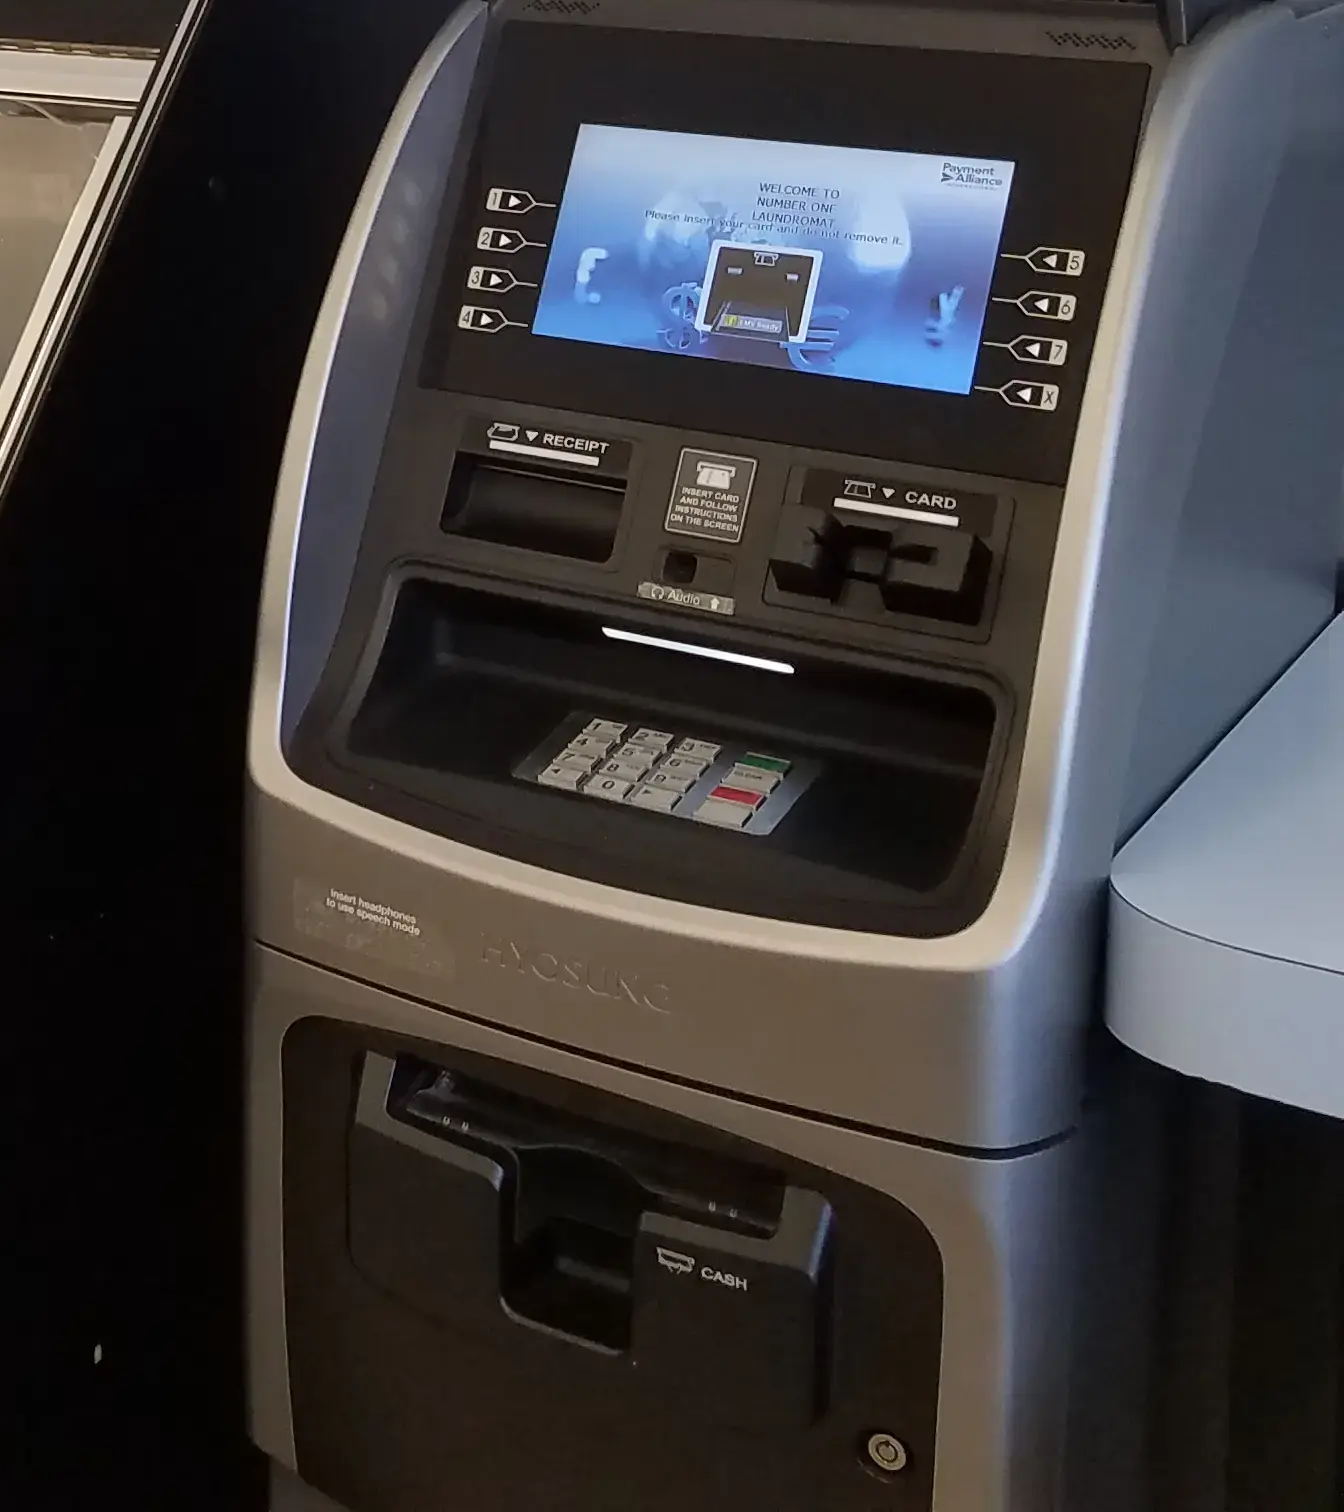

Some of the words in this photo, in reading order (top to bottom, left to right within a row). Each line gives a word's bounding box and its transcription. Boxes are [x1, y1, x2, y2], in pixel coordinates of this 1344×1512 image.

[943, 162, 995, 176] Payment
[955, 173, 1003, 186] Alliance
[758, 182, 818, 199] WELCOME
[823, 187, 841, 199] TO
[492, 192, 499, 206] 1
[756, 196, 807, 212] NUMBER
[645, 209, 681, 222] Please
[719, 218, 744, 231] your
[748, 220, 773, 232] card
[844, 231, 888, 244] remove
[752, 210, 836, 229] LAUNDROMAT
[481, 231, 490, 246] 2
[1069, 255, 1080, 270] 5
[471, 270, 480, 285] 3
[1061, 299, 1071, 315] 6
[462, 310, 471, 324] 4
[1053, 344, 1063, 360] 7
[1043, 390, 1055, 405] X
[542, 433, 610, 454] RECEIPT
[681, 486, 714, 498] INSERT
[714, 492, 740, 503] CARD
[905, 491, 958, 510] CARD
[680, 495, 699, 506] AND
[700, 500, 738, 512] FOLLOW
[675, 504, 738, 522] INSTRUCTIONS
[670, 513, 683, 522] ON
[685, 516, 702, 526] THE
[703, 519, 740, 532] SCREEN
[667, 589, 700, 605] Audio
[330, 888, 357, 905] Insert
[358, 897, 417, 924] headphones
[326, 897, 336, 908] to
[337, 903, 355, 915] use
[356, 908, 391, 926] speech
[392, 920, 421, 936] mode
[700, 1266, 748, 1291] CASH
